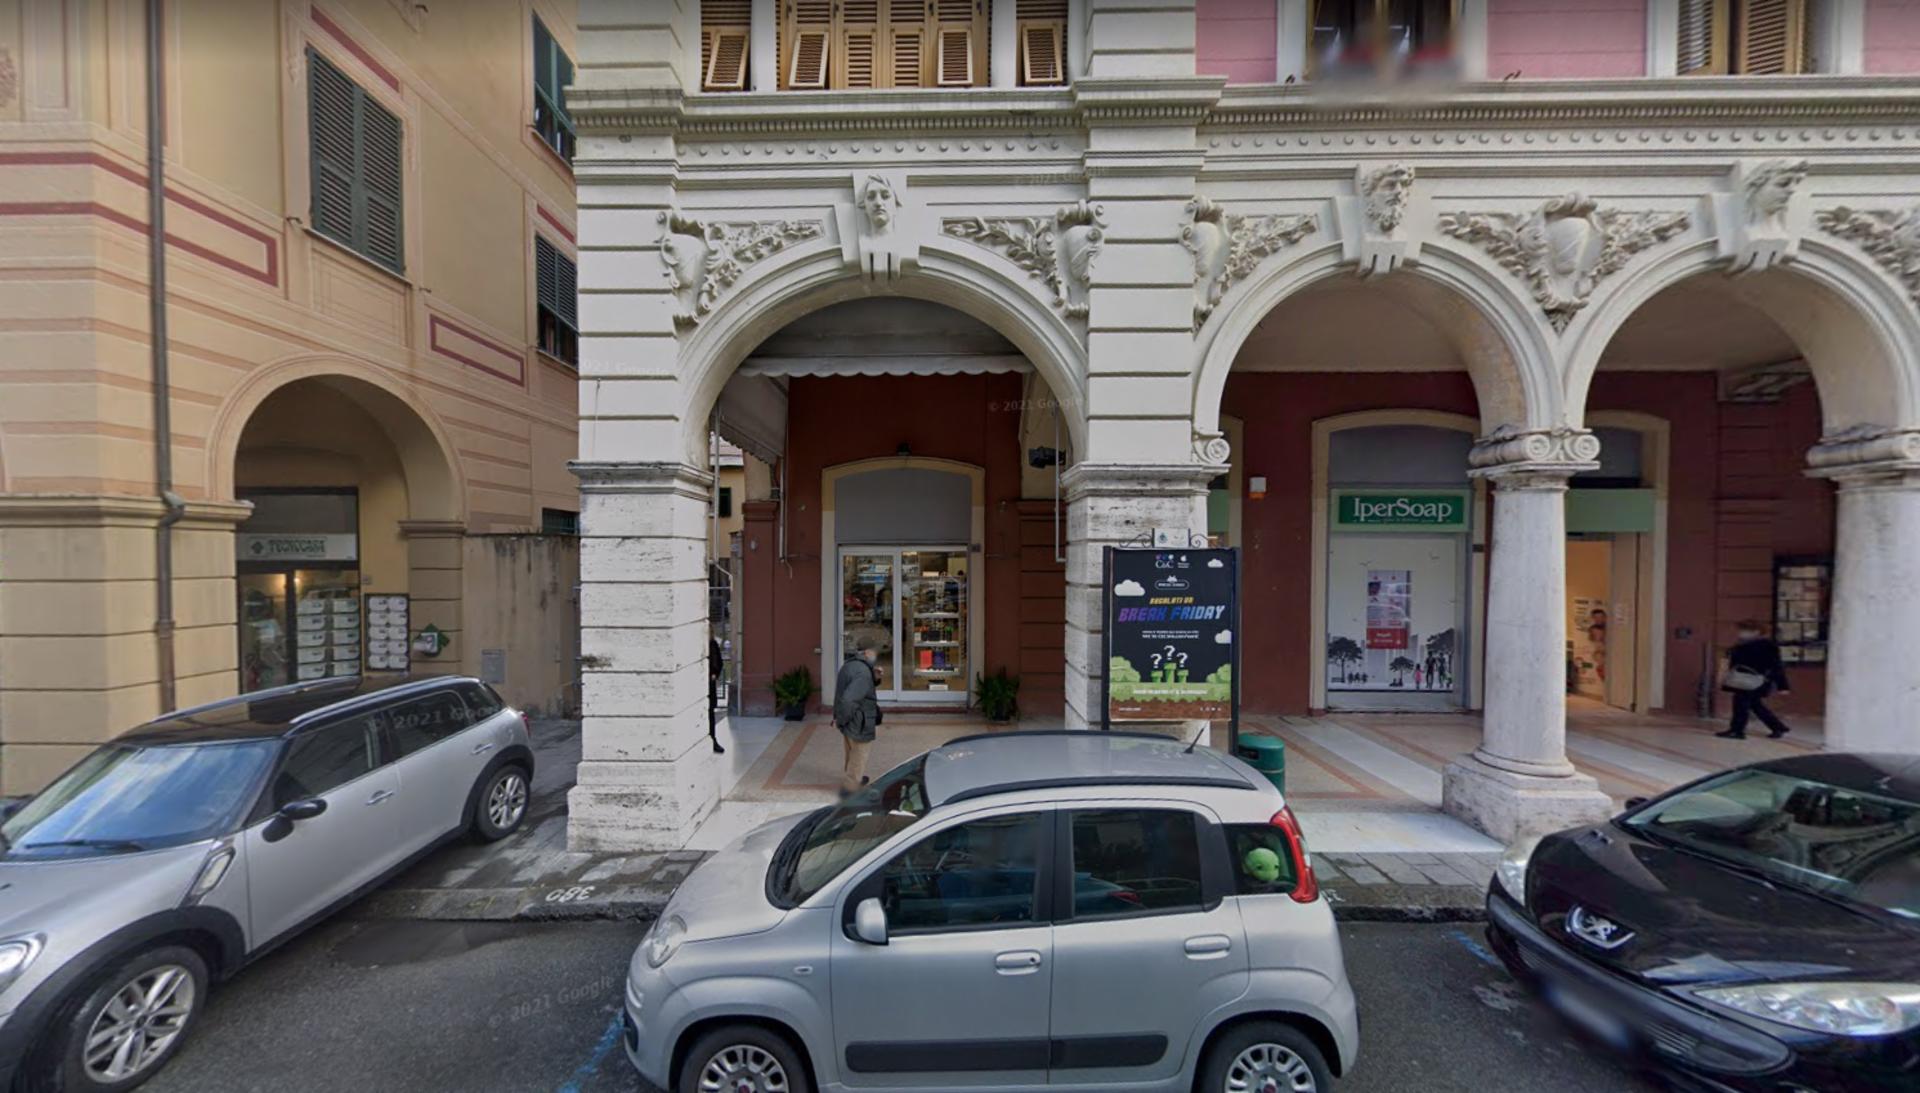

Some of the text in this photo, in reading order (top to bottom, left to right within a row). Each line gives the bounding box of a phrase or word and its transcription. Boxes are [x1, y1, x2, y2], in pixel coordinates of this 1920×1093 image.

[1353, 497, 1453, 522] IperSoap
[1118, 604, 1225, 622] BREAK FRIDAY
